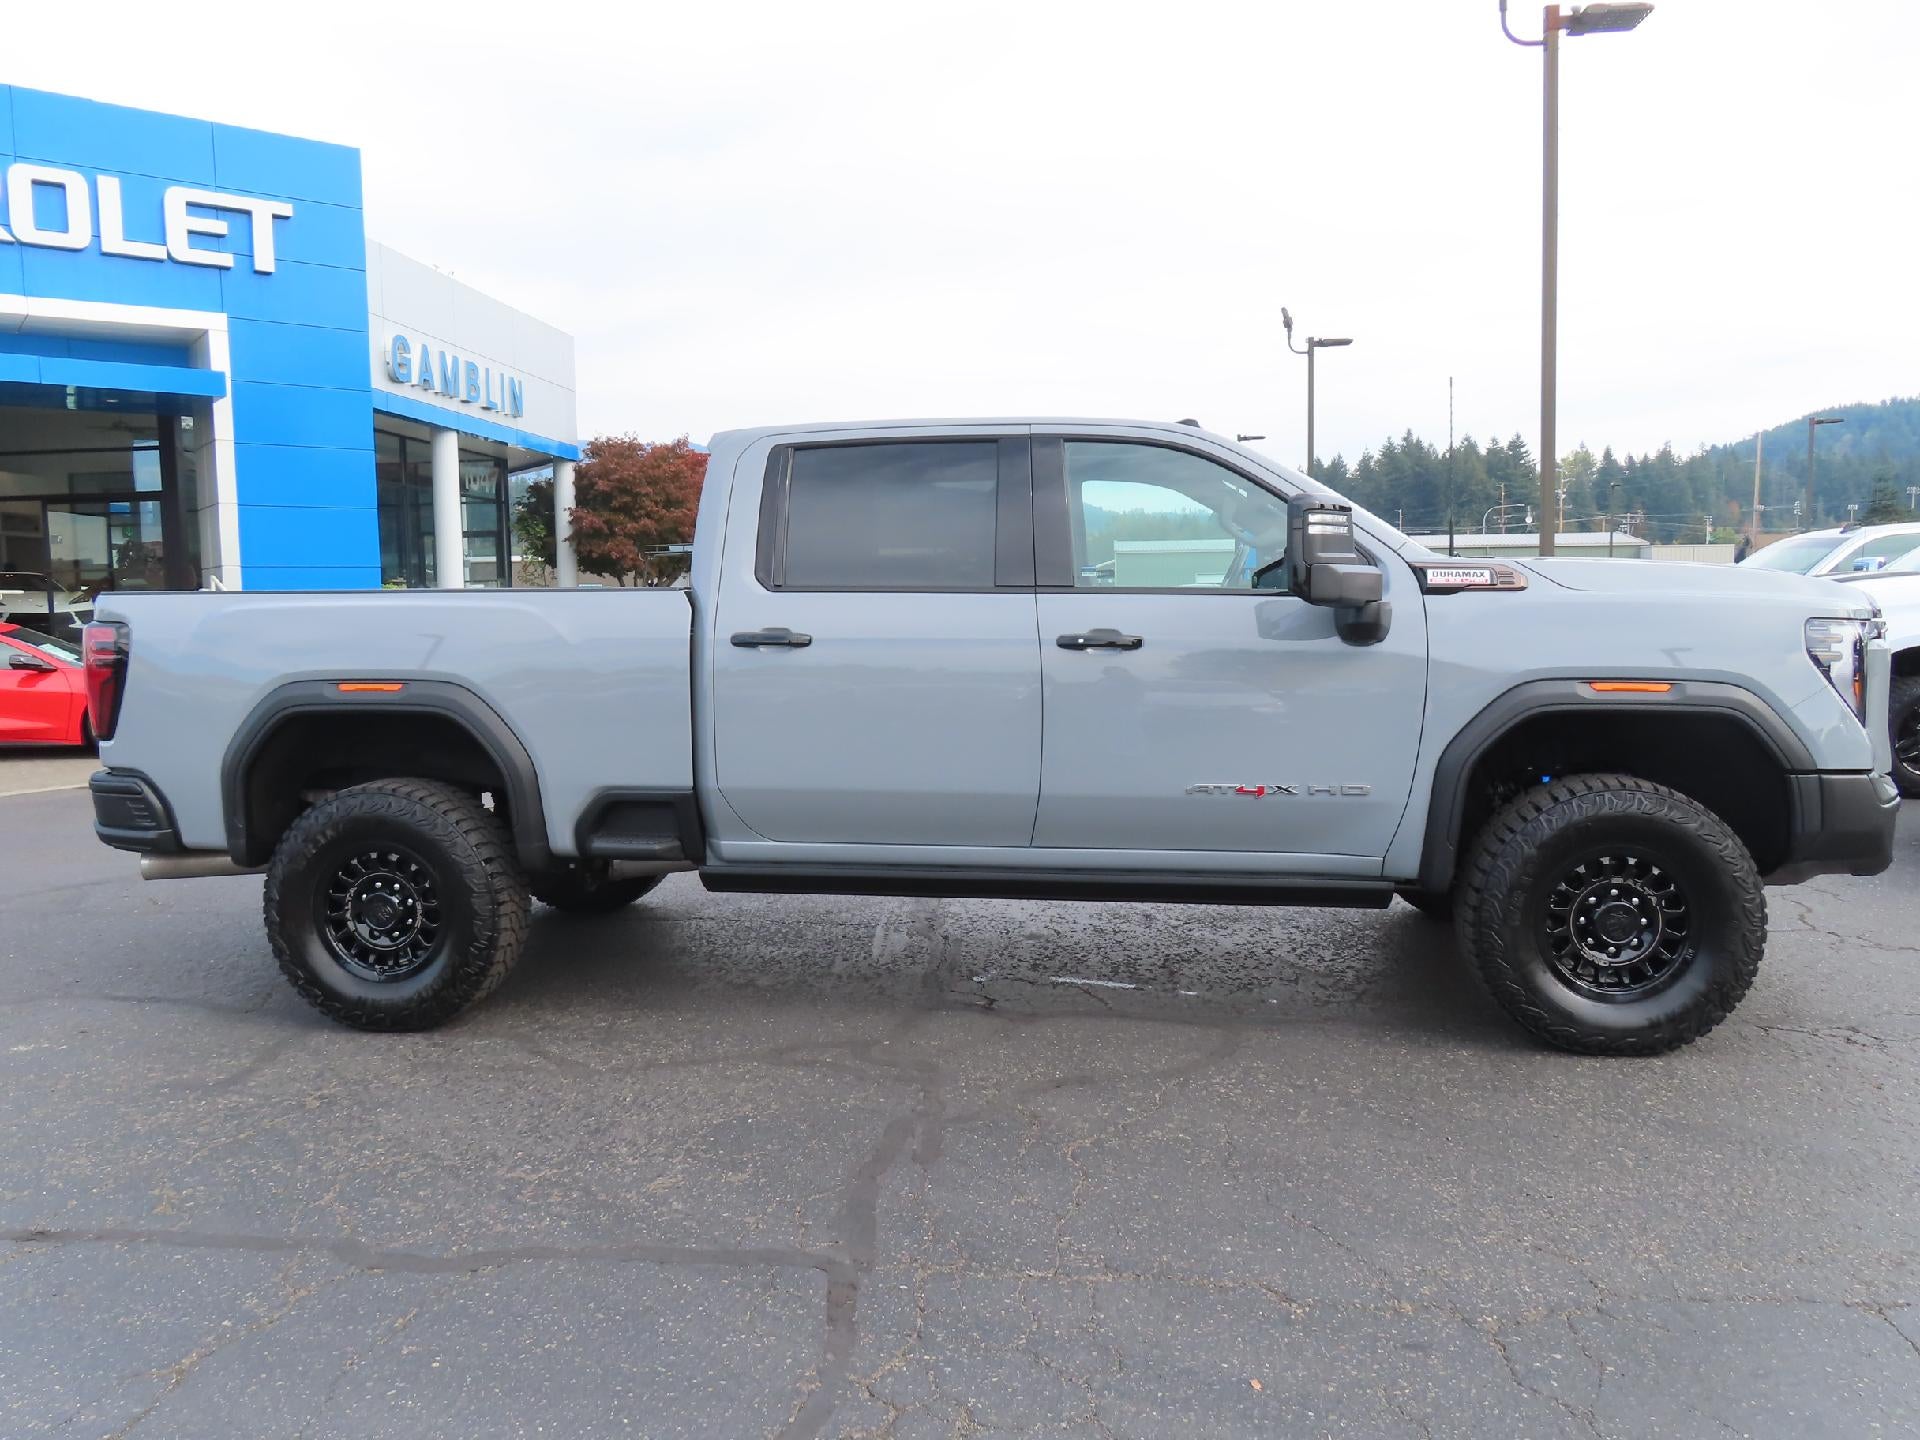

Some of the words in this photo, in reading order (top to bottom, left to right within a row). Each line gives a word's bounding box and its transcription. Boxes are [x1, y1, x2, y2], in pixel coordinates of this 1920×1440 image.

[385, 334, 523, 418] GAMBLIN
[1185, 783, 1299, 799] AT4X
[1307, 784, 1373, 796] HD
